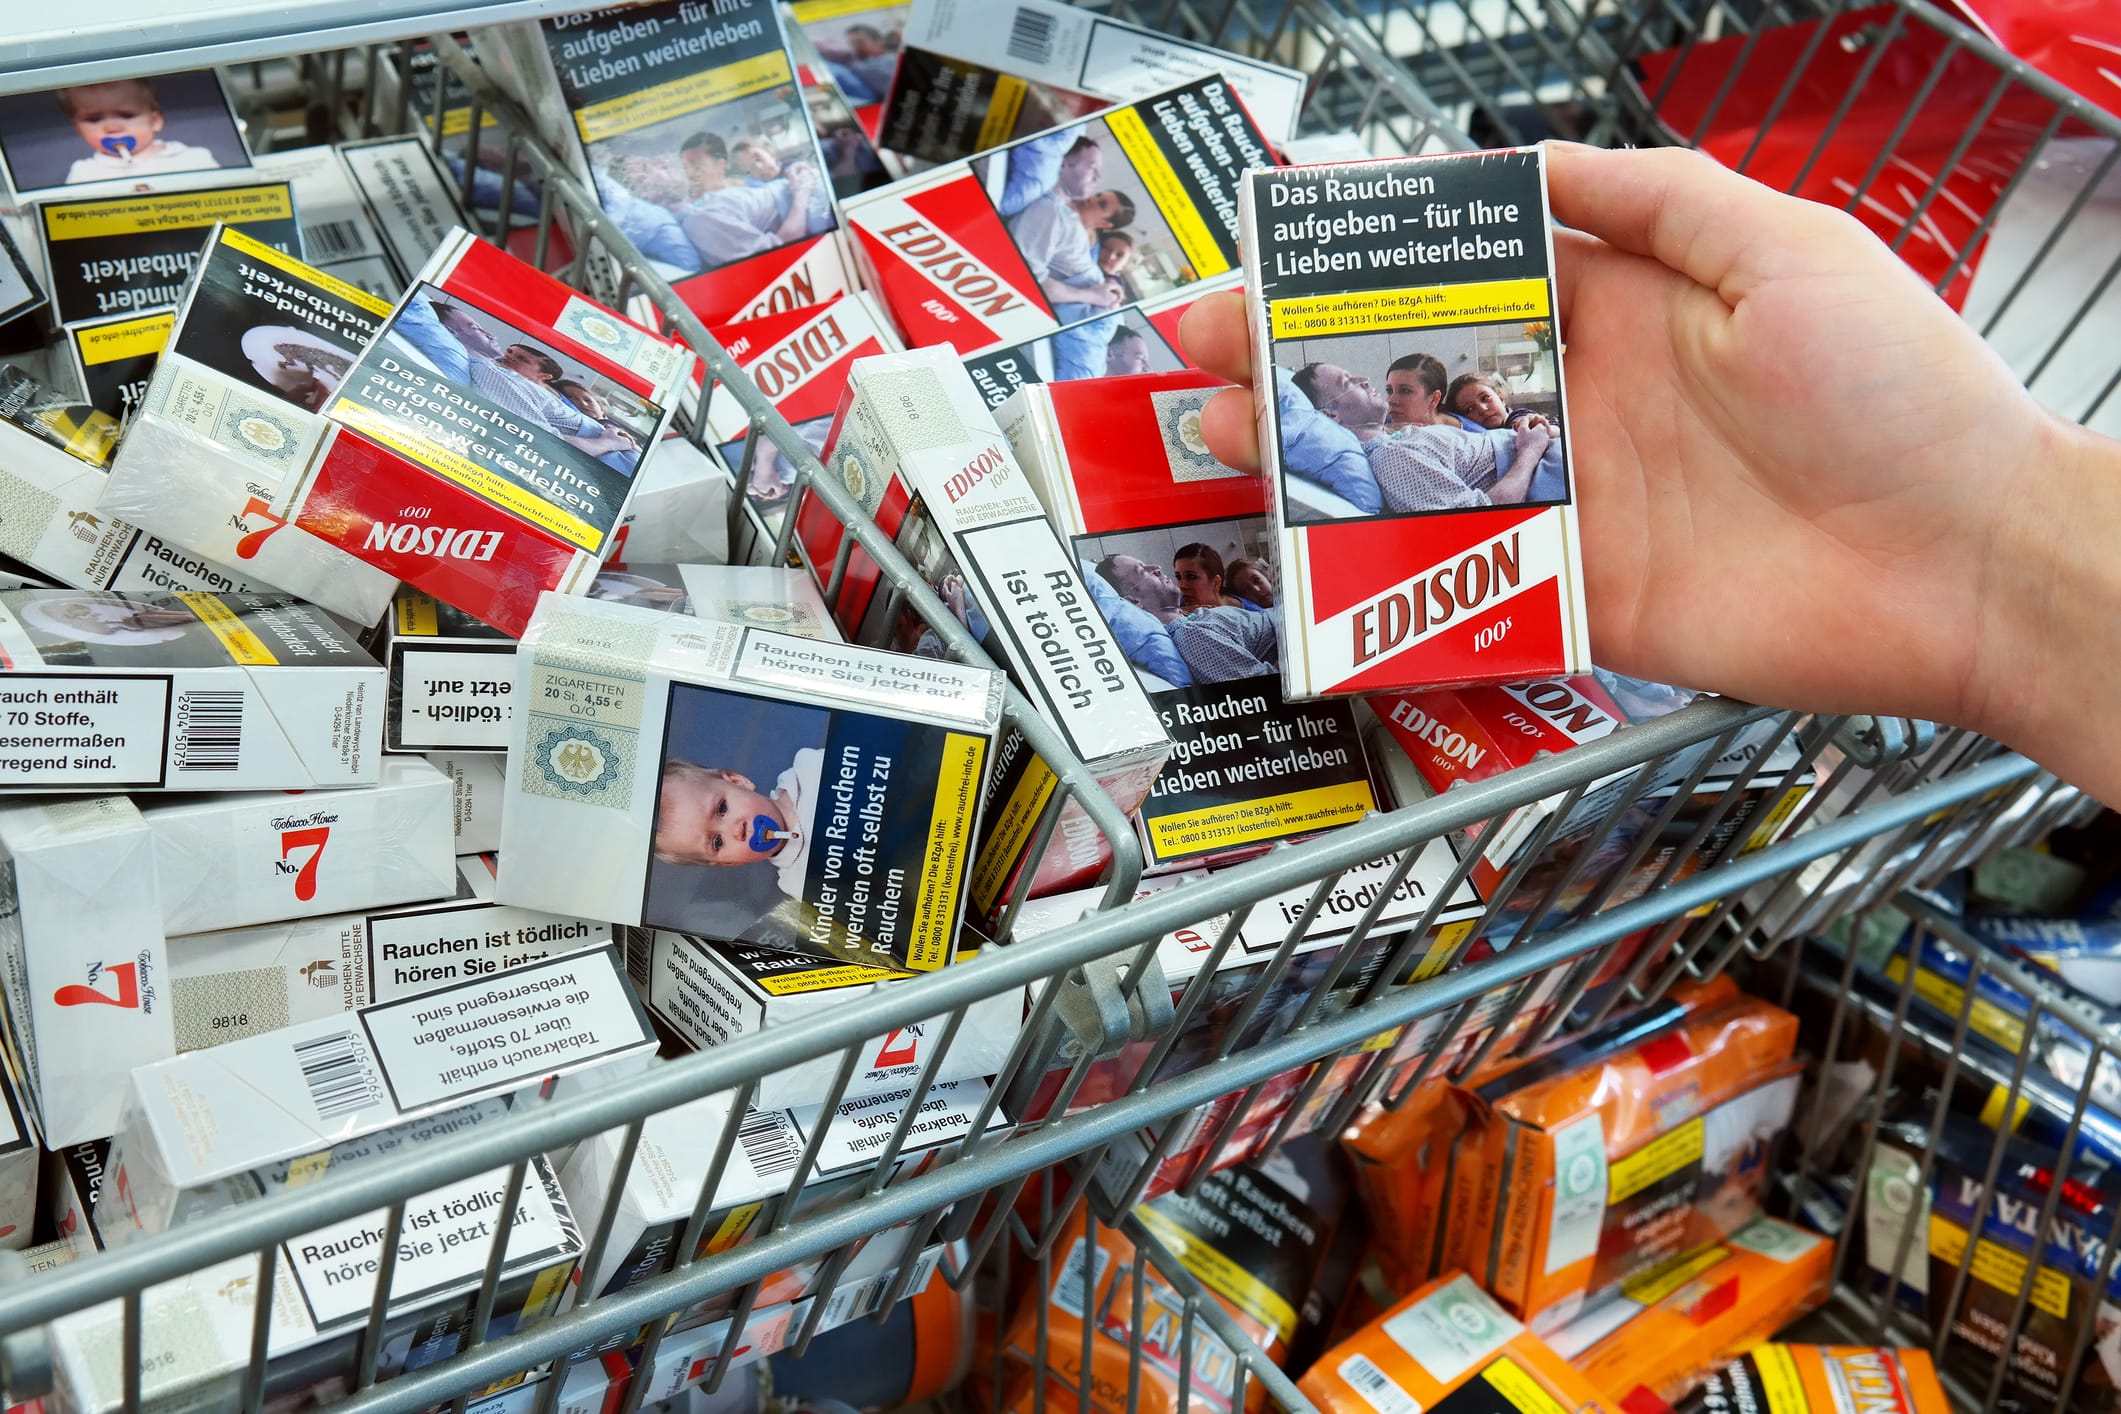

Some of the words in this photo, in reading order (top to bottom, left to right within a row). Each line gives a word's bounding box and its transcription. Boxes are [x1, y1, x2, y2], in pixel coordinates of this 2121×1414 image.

[562, 19, 659, 67] aufgeben
[679, 2, 707, 25] für
[569, 56, 640, 88] Lieben
[642, 19, 763, 67] weiterleben
[1153, 100, 1193, 154] Lieben
[1177, 93, 1232, 167] aufgeben
[1201, 82, 1230, 116] Das
[1221, 113, 1270, 175] Rauche
[1270, 178, 1317, 206] Das
[1325, 172, 1433, 201] Rauchen
[1274, 210, 1395, 243] aufgeben
[1424, 203, 1462, 228] für
[1469, 200, 1518, 224] Ihre
[880, 219, 1025, 318] EDISON
[1276, 247, 1361, 275] Lieben
[1368, 234, 1522, 267] weiterleben
[243, 282, 337, 331] mindert
[1281, 305, 1313, 315] Wollen
[1316, 304, 1329, 312] Sie
[1332, 299, 1378, 310] aufhören?
[1381, 298, 1395, 306] Die
[1398, 296, 1422, 306] BZgA
[1425, 293, 1445, 303] hilft:
[1283, 320, 1301, 329] Tel.:
[1304, 318, 1326, 327] 0800
[1338, 314, 1370, 325] 313131
[1374, 310, 1429, 323] (kostenfrei),
[1432, 302, 1534, 317] www.rauchfrei-info.de
[753, 313, 848, 397] EDISO
[380, 358, 426, 387] Das
[431, 382, 534, 442] Rauchen
[360, 385, 443, 438] Lieben
[445, 430, 595, 513] weiterleben
[364, 374, 486, 438] aufgeben
[511, 444, 549, 469] für
[553, 465, 600, 497] Ihre
[943, 444, 1004, 504] EDISON
[487, 487, 586, 539] www.rauchfrei-info.de
[955, 501, 1002, 515] RAUCHEN:
[1003, 496, 1028, 508] BITTE
[955, 515, 975, 525] NUR
[976, 503, 1037, 521] ERWACHSENE
[228, 514, 250, 534] No.
[237, 496, 288, 559] 7
[363, 522, 504, 561] EDISON
[85, 529, 116, 575] RAUCHEN:
[144, 536, 233, 591] Rauchen
[93, 565, 108, 585] NUR
[1352, 532, 1520, 667] EDISON
[1002, 570, 1038, 607] ist
[1025, 611, 1091, 710] tödlich
[1044, 570, 1124, 694] Rauchen
[754, 642, 849, 666] Rauchen
[857, 661, 883, 672] ist
[889, 667, 962, 685] tödlich
[761, 656, 824, 676] hören
[831, 669, 864, 682] Sie
[870, 676, 919, 691] jetzt
[54, 690, 117, 703] enthält
[356, 682, 364, 702] Heintz
[424, 680, 463, 695] auf.
[544, 689, 559, 700] 20
[584, 694, 609, 706] 4,55
[546, 674, 624, 695] ZIGARETTEN
[7, 712, 28, 724] 70
[35, 711, 94, 727] Stoffe,
[177, 695, 189, 727] 2904
[333, 707, 342, 731] D-54294
[428, 705, 501, 720] tödlich
[1176, 694, 1266, 724] Rauchen
[332, 733, 340, 748] Trier
[351, 717, 362, 752] Landewyck
[1262, 720, 1292, 741] für
[1296, 715, 1336, 737] Ihre
[1389, 700, 1487, 770] EDISON
[73, 755, 116, 768] sind.
[174, 735, 187, 768] 5075
[351, 754, 359, 773] GmbH
[872, 756, 890, 779] zu
[1224, 747, 1346, 783] weiterleben
[825, 746, 859, 839] Rauchern
[953, 746, 975, 838] www.rauchfrei-info.de
[270, 817, 309, 830] Tobacco
[311, 813, 339, 825] House
[859, 783, 886, 842] selbst
[1158, 822, 1186, 832] Wollen
[1187, 819, 1199, 827] Sie
[1201, 811, 1238, 825] aufhören?
[1240, 809, 1253, 818] Die
[1254, 804, 1274, 816] BZgA
[1180, 832, 1199, 843] 0800
[1207, 826, 1235, 838] 313131
[1237, 817, 1282, 833] (kostenfrei),
[1283, 802, 1364, 825] www.rauchfrei-info.de
[931, 840, 943, 862] BZgA
[1061, 814, 1099, 871] EDISON
[275, 859, 299, 876] No.
[281, 826, 330, 902] 7
[824, 845, 843, 880] von
[853, 847, 875, 874] oft
[928, 864, 938, 877] Die
[941, 840, 959, 888] (kostenfrei),
[806, 883, 836, 944] Kinder
[844, 880, 870, 949] werden
[870, 868, 904, 954] Rauchern
[922, 879, 935, 919] aufhören?
[936, 890, 949, 918] 313131
[341, 930, 350, 958] BITTE
[382, 938, 477, 960] Rauchen
[485, 931, 510, 947] ist
[516, 921, 587, 943] tödlich
[918, 921, 928, 932] Sie
[931, 927, 942, 945] 0800
[352, 924, 363, 992] ERWACHSENE
[913, 935, 925, 960] Wollen
[54, 962, 139, 1009] 7
[86, 961, 103, 986] No.
[138, 949, 153, 988] Tobacco
[394, 965, 456, 983] hören
[463, 958, 495, 975] Sie
[140, 987, 153, 1015] House
[456, 974, 576, 1014] krebserregend
[565, 991, 589, 1004] die
[212, 1013, 247, 1028] 9818
[412, 1006, 452, 1025] sind.
[413, 998, 560, 1044] erwiesenermaßen
[533, 1017, 570, 1034] über
[450, 1034, 506, 1056] Stoffe,
[502, 1031, 598, 1066] Tabakrauch
[510, 1028, 530, 1043] 70
[439, 1059, 497, 1084] enthält
[852, 1111, 897, 1128] Stoffe,
[409, 1209, 439, 1229] ist
[395, 1242, 433, 1262] Sie
[437, 1221, 489, 1253] jetzt
[626, 1236, 672, 1287] rstopft
[1846, 1353, 1897, 1414] NCIA
